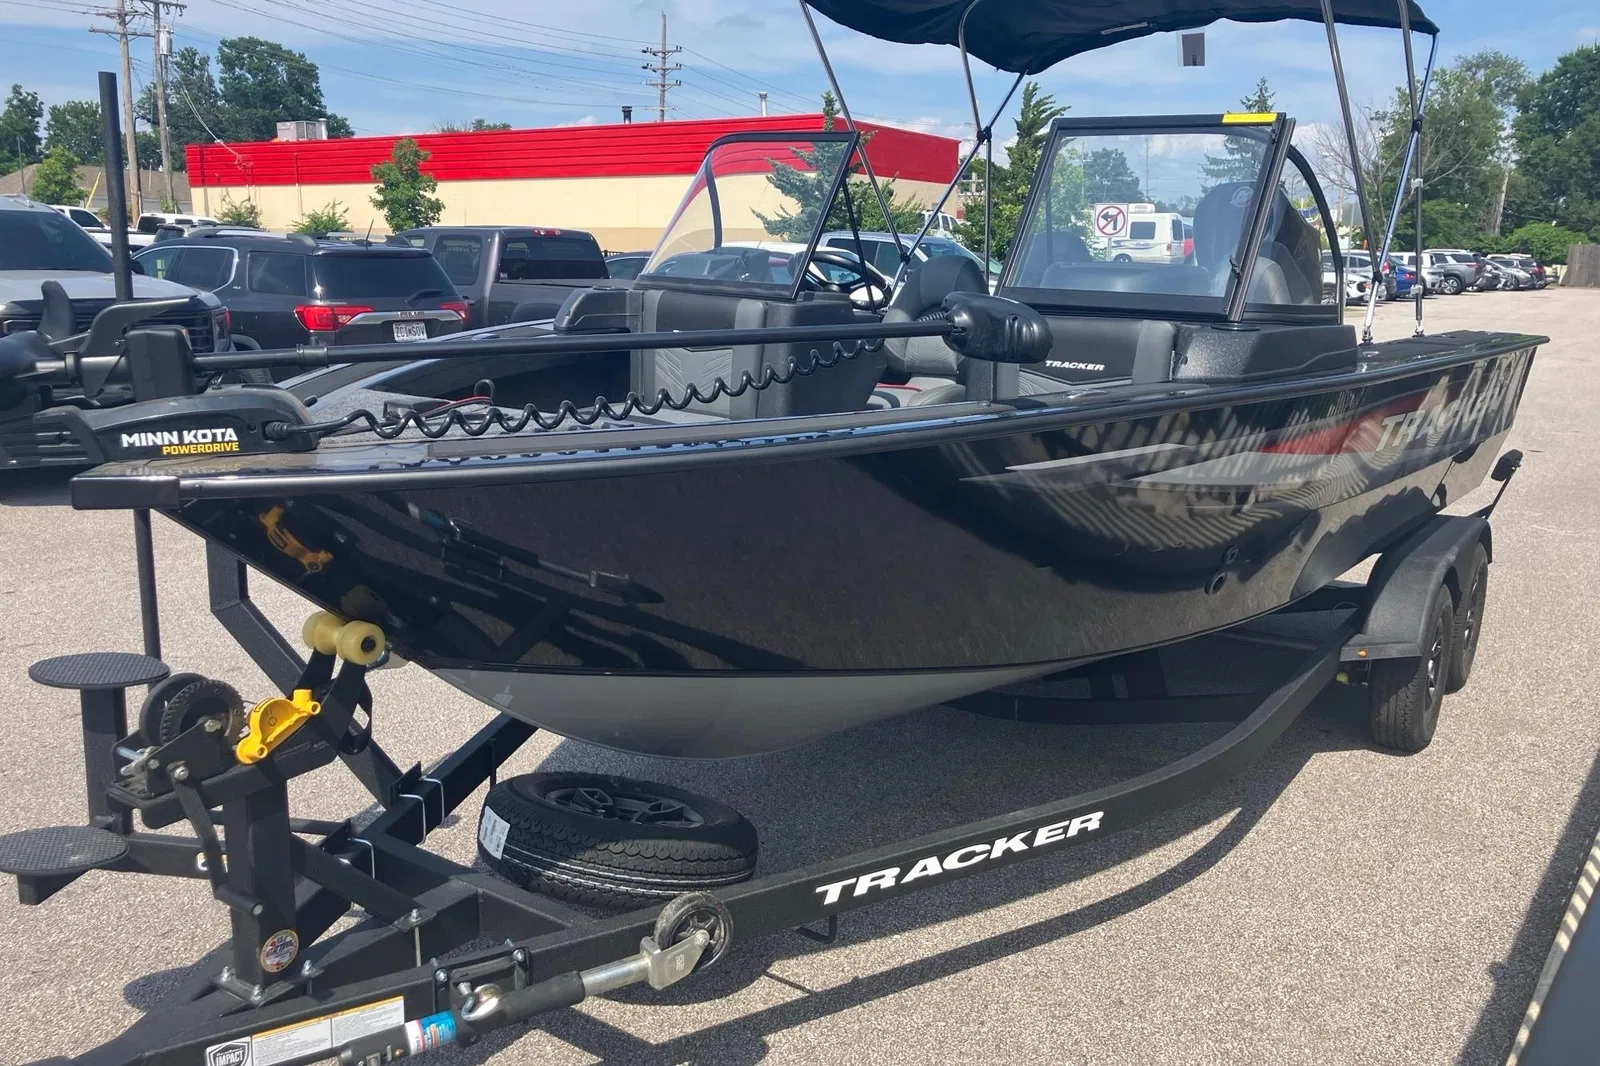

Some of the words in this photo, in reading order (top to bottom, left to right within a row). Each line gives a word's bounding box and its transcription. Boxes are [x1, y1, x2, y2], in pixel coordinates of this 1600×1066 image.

[1045, 360, 1105, 371] TRACKER
[121, 431, 179, 447] MINN
[183, 428, 238, 444] KOTA
[162, 442, 240, 455] POWERDRIVE
[815, 811, 1104, 905] TRACKER
[216, 1050, 244, 1066] IMPACT
